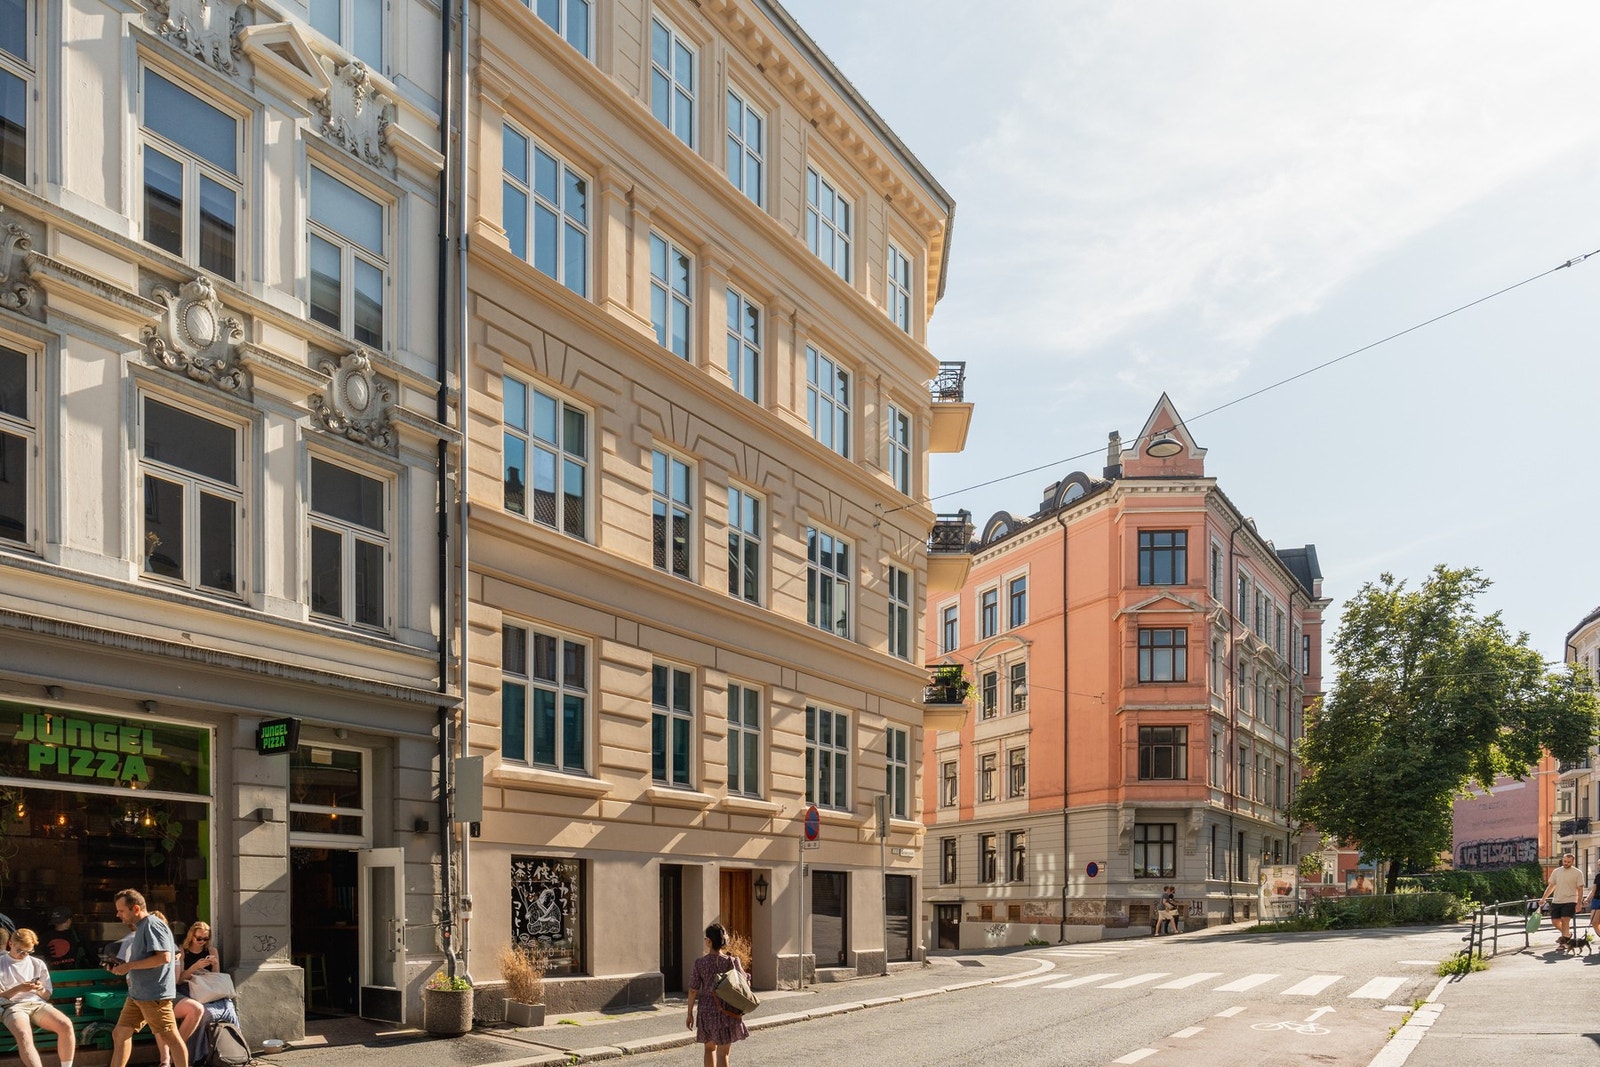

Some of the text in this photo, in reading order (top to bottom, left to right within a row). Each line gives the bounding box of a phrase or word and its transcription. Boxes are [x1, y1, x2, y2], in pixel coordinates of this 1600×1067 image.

[14, 713, 163, 757] JUNGEL
[261, 723, 288, 739] JUNGEL
[263, 735, 286, 749] PIZZA
[28, 743, 150, 783] PIZZA
